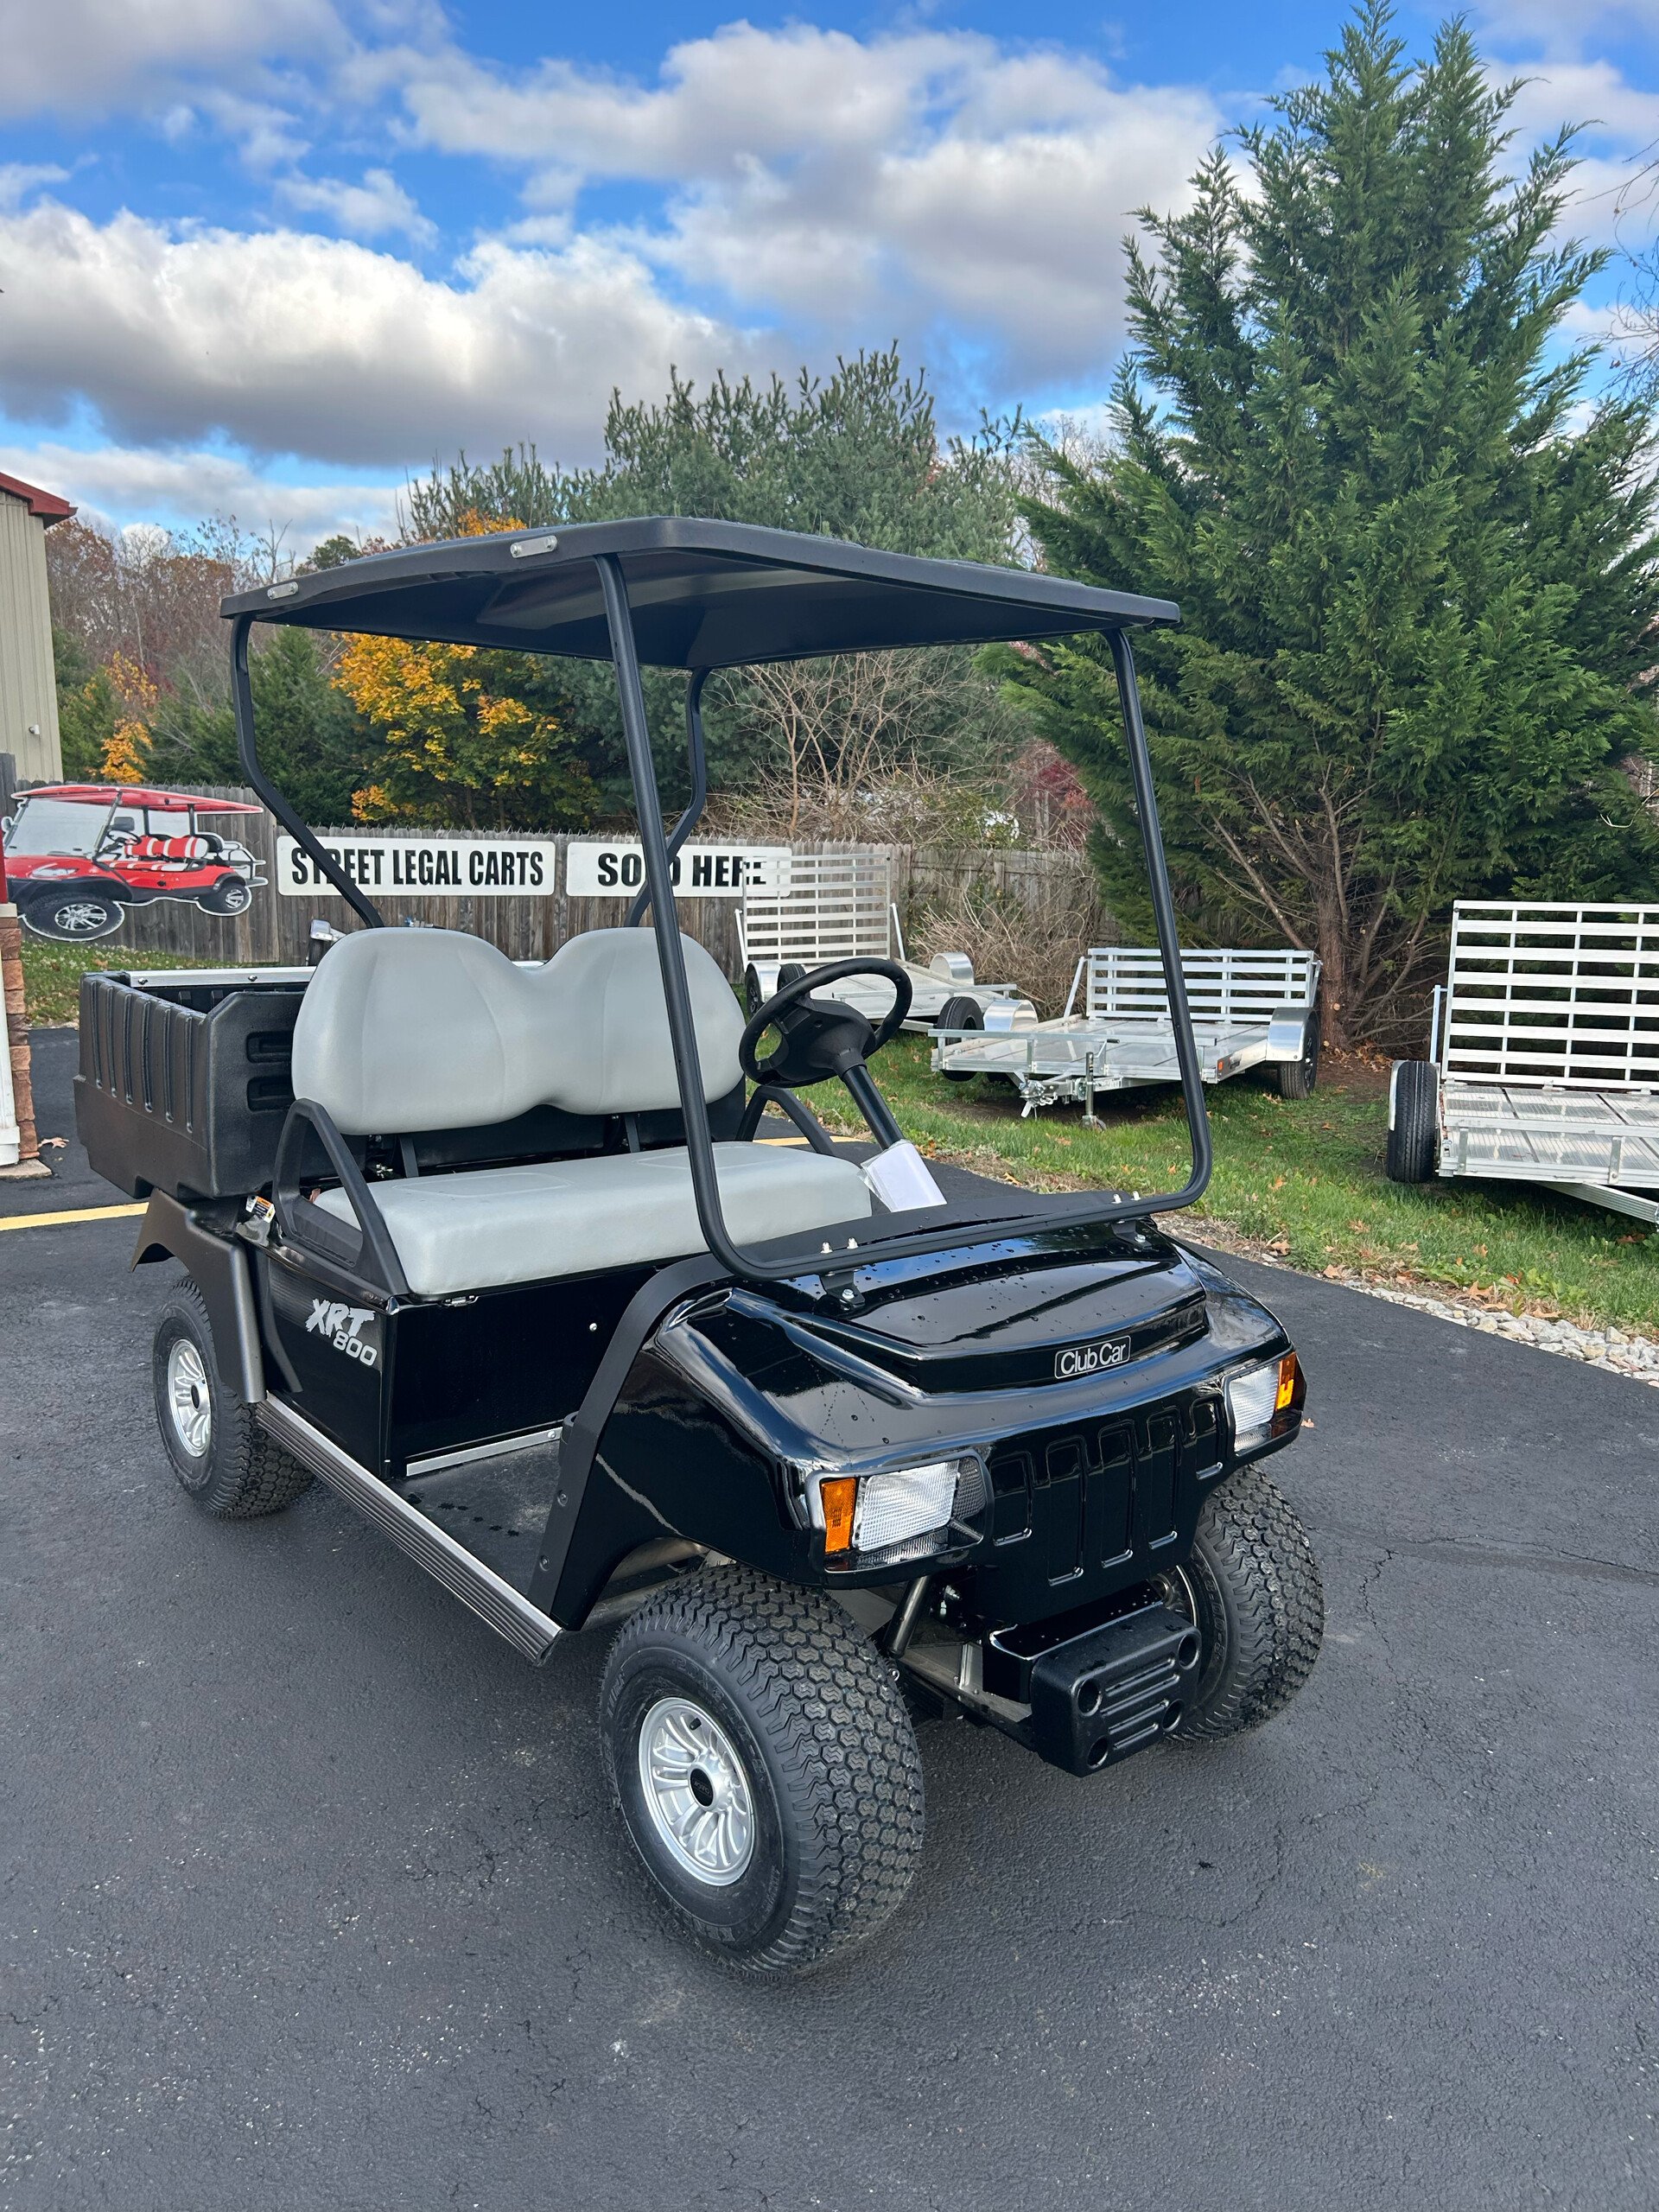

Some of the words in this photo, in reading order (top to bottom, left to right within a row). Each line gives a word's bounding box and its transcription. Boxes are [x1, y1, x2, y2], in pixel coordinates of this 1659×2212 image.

[392, 849, 462, 886] LEGAL
[469, 850, 543, 886] CARTS
[598, 853, 681, 887] SOD
[305, 1298, 376, 1338] XRT
[333, 1331, 378, 1366] 800
[1060, 1348, 1098, 1375] Club
[1099, 1343, 1126, 1365] Car
